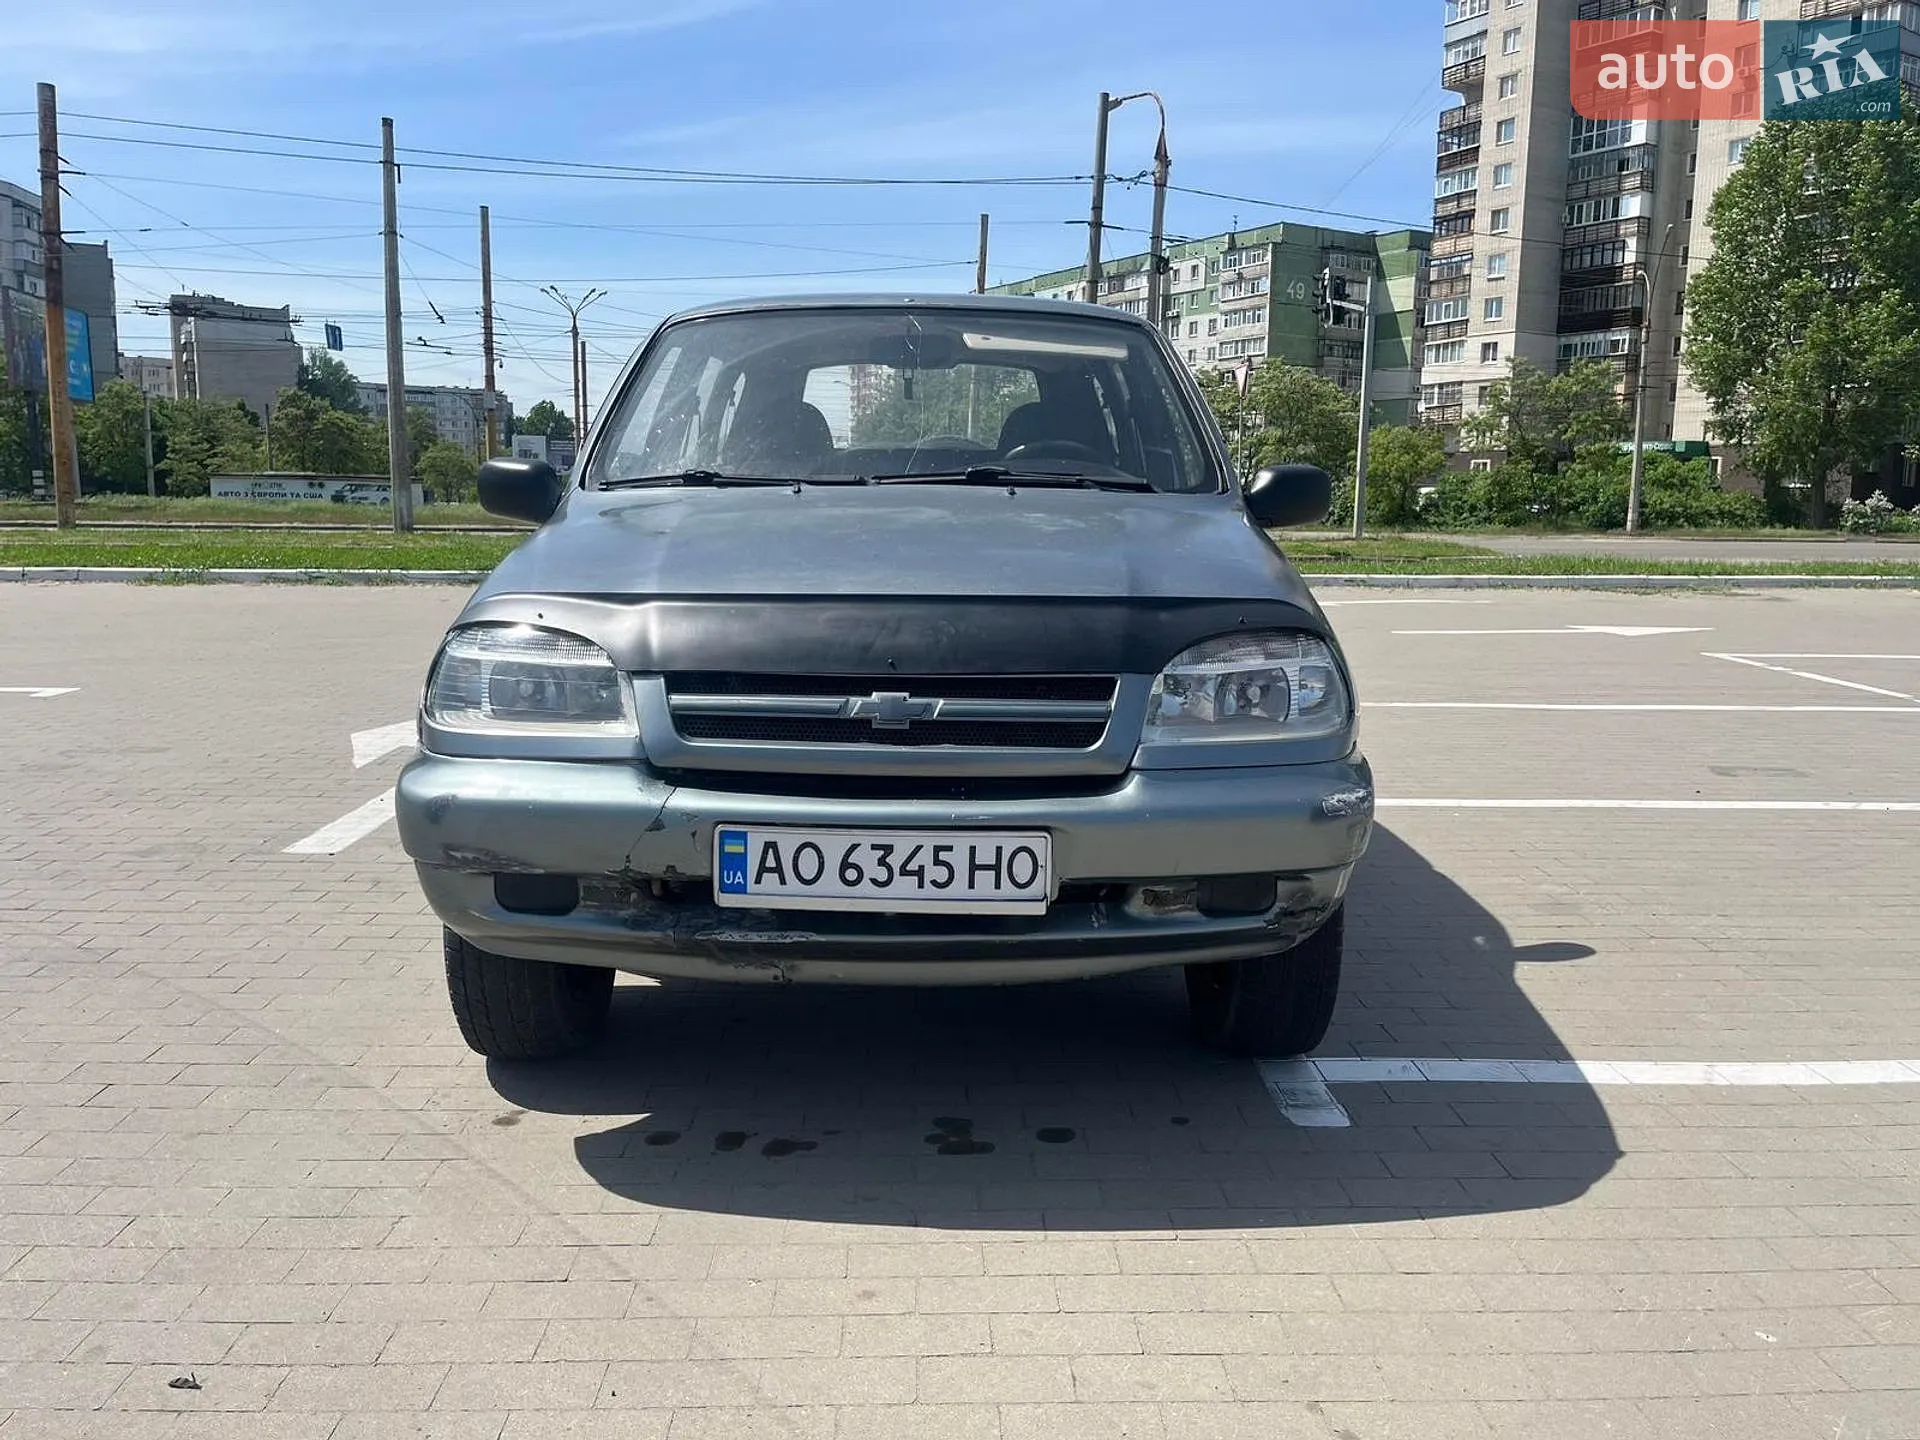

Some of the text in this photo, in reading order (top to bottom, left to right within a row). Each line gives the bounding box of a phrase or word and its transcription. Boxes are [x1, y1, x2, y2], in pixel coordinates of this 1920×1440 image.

[1286, 280, 1305, 300] 49
[217, 490, 241, 498] АВТО
[753, 841, 1039, 890] AO 6345 HO
[723, 870, 745, 885] UA
